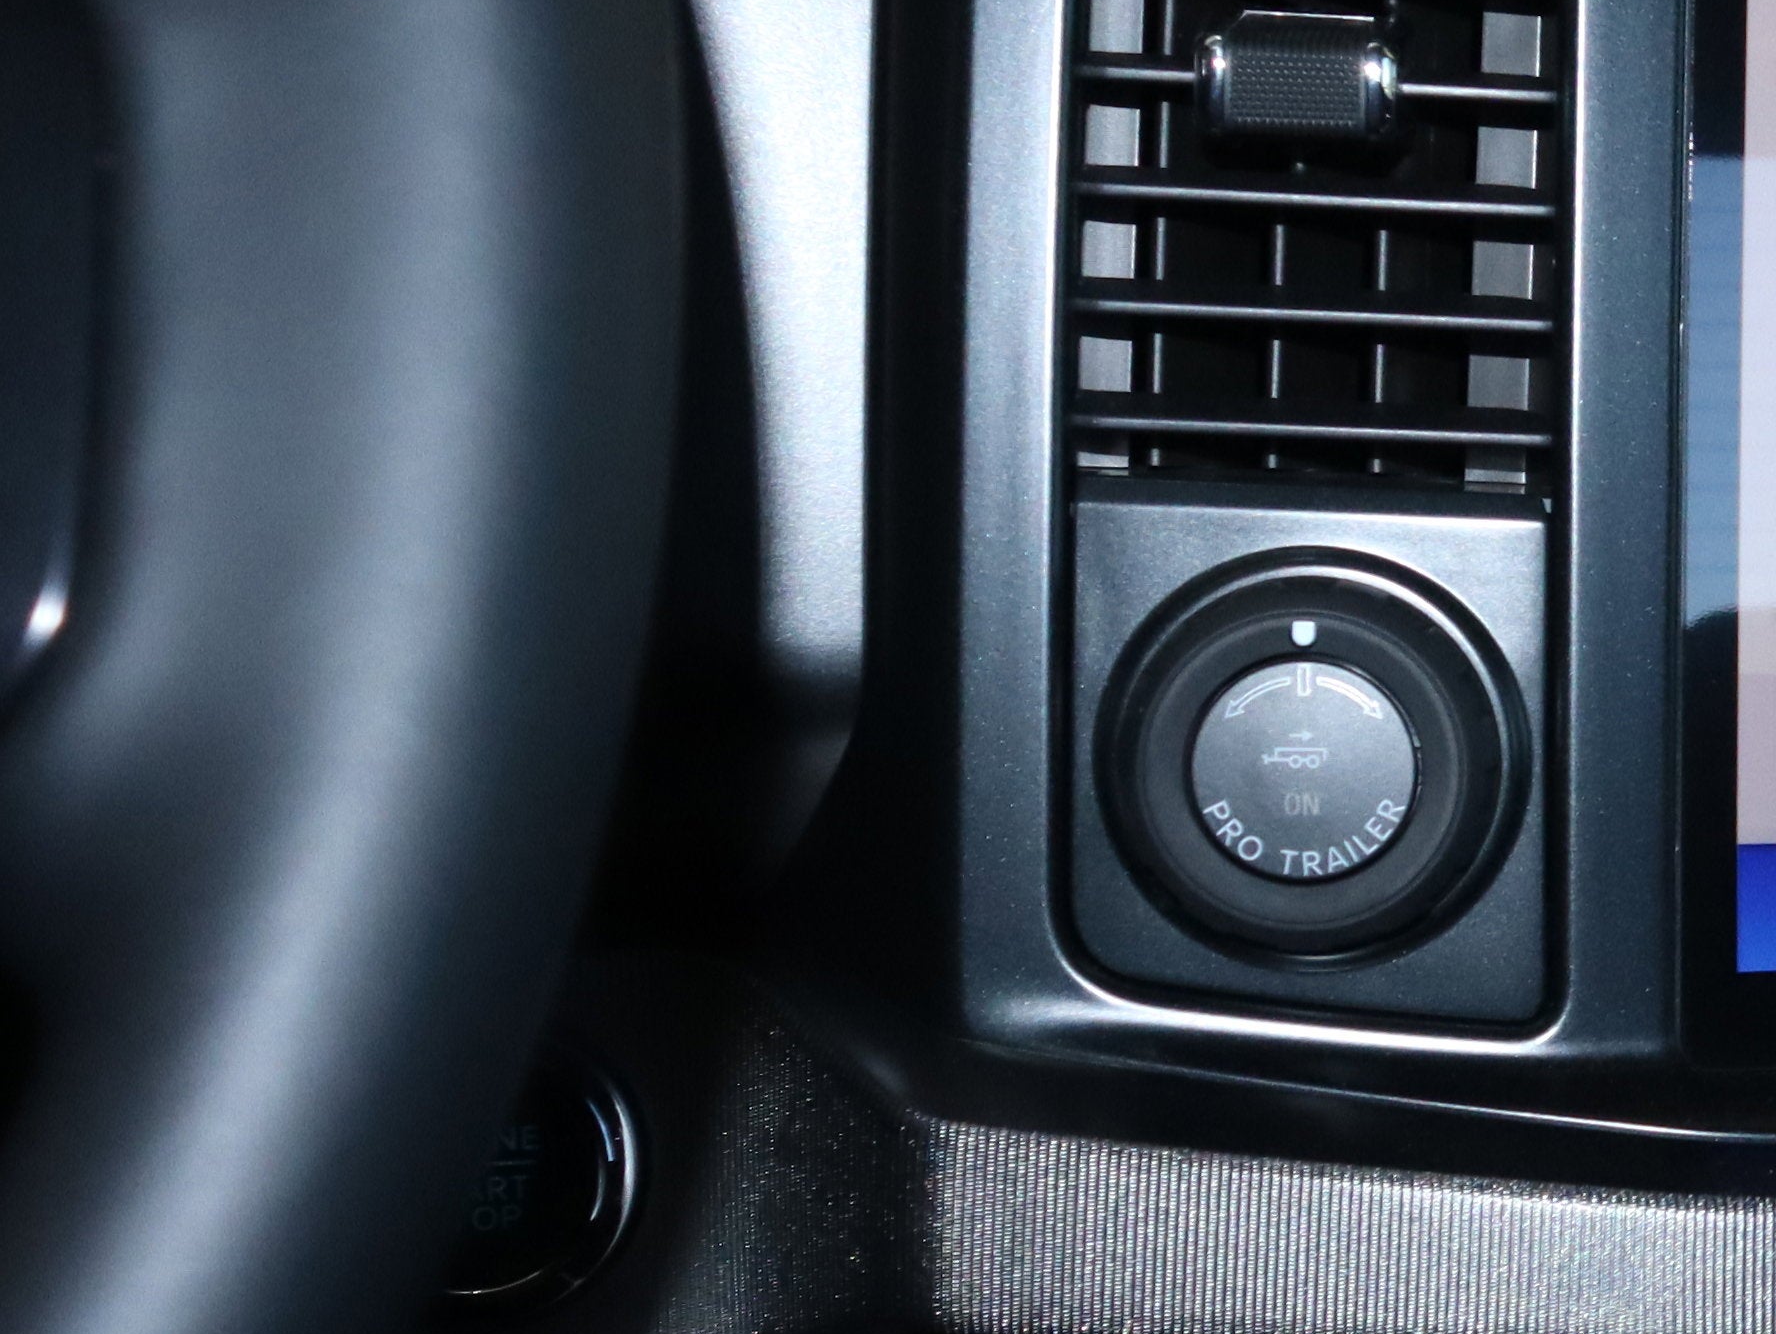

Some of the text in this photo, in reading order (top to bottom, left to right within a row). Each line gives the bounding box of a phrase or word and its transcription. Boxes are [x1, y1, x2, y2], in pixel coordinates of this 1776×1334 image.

[1283, 793, 1321, 816] ON
[1203, 798, 1407, 877] PRO TRAILER
